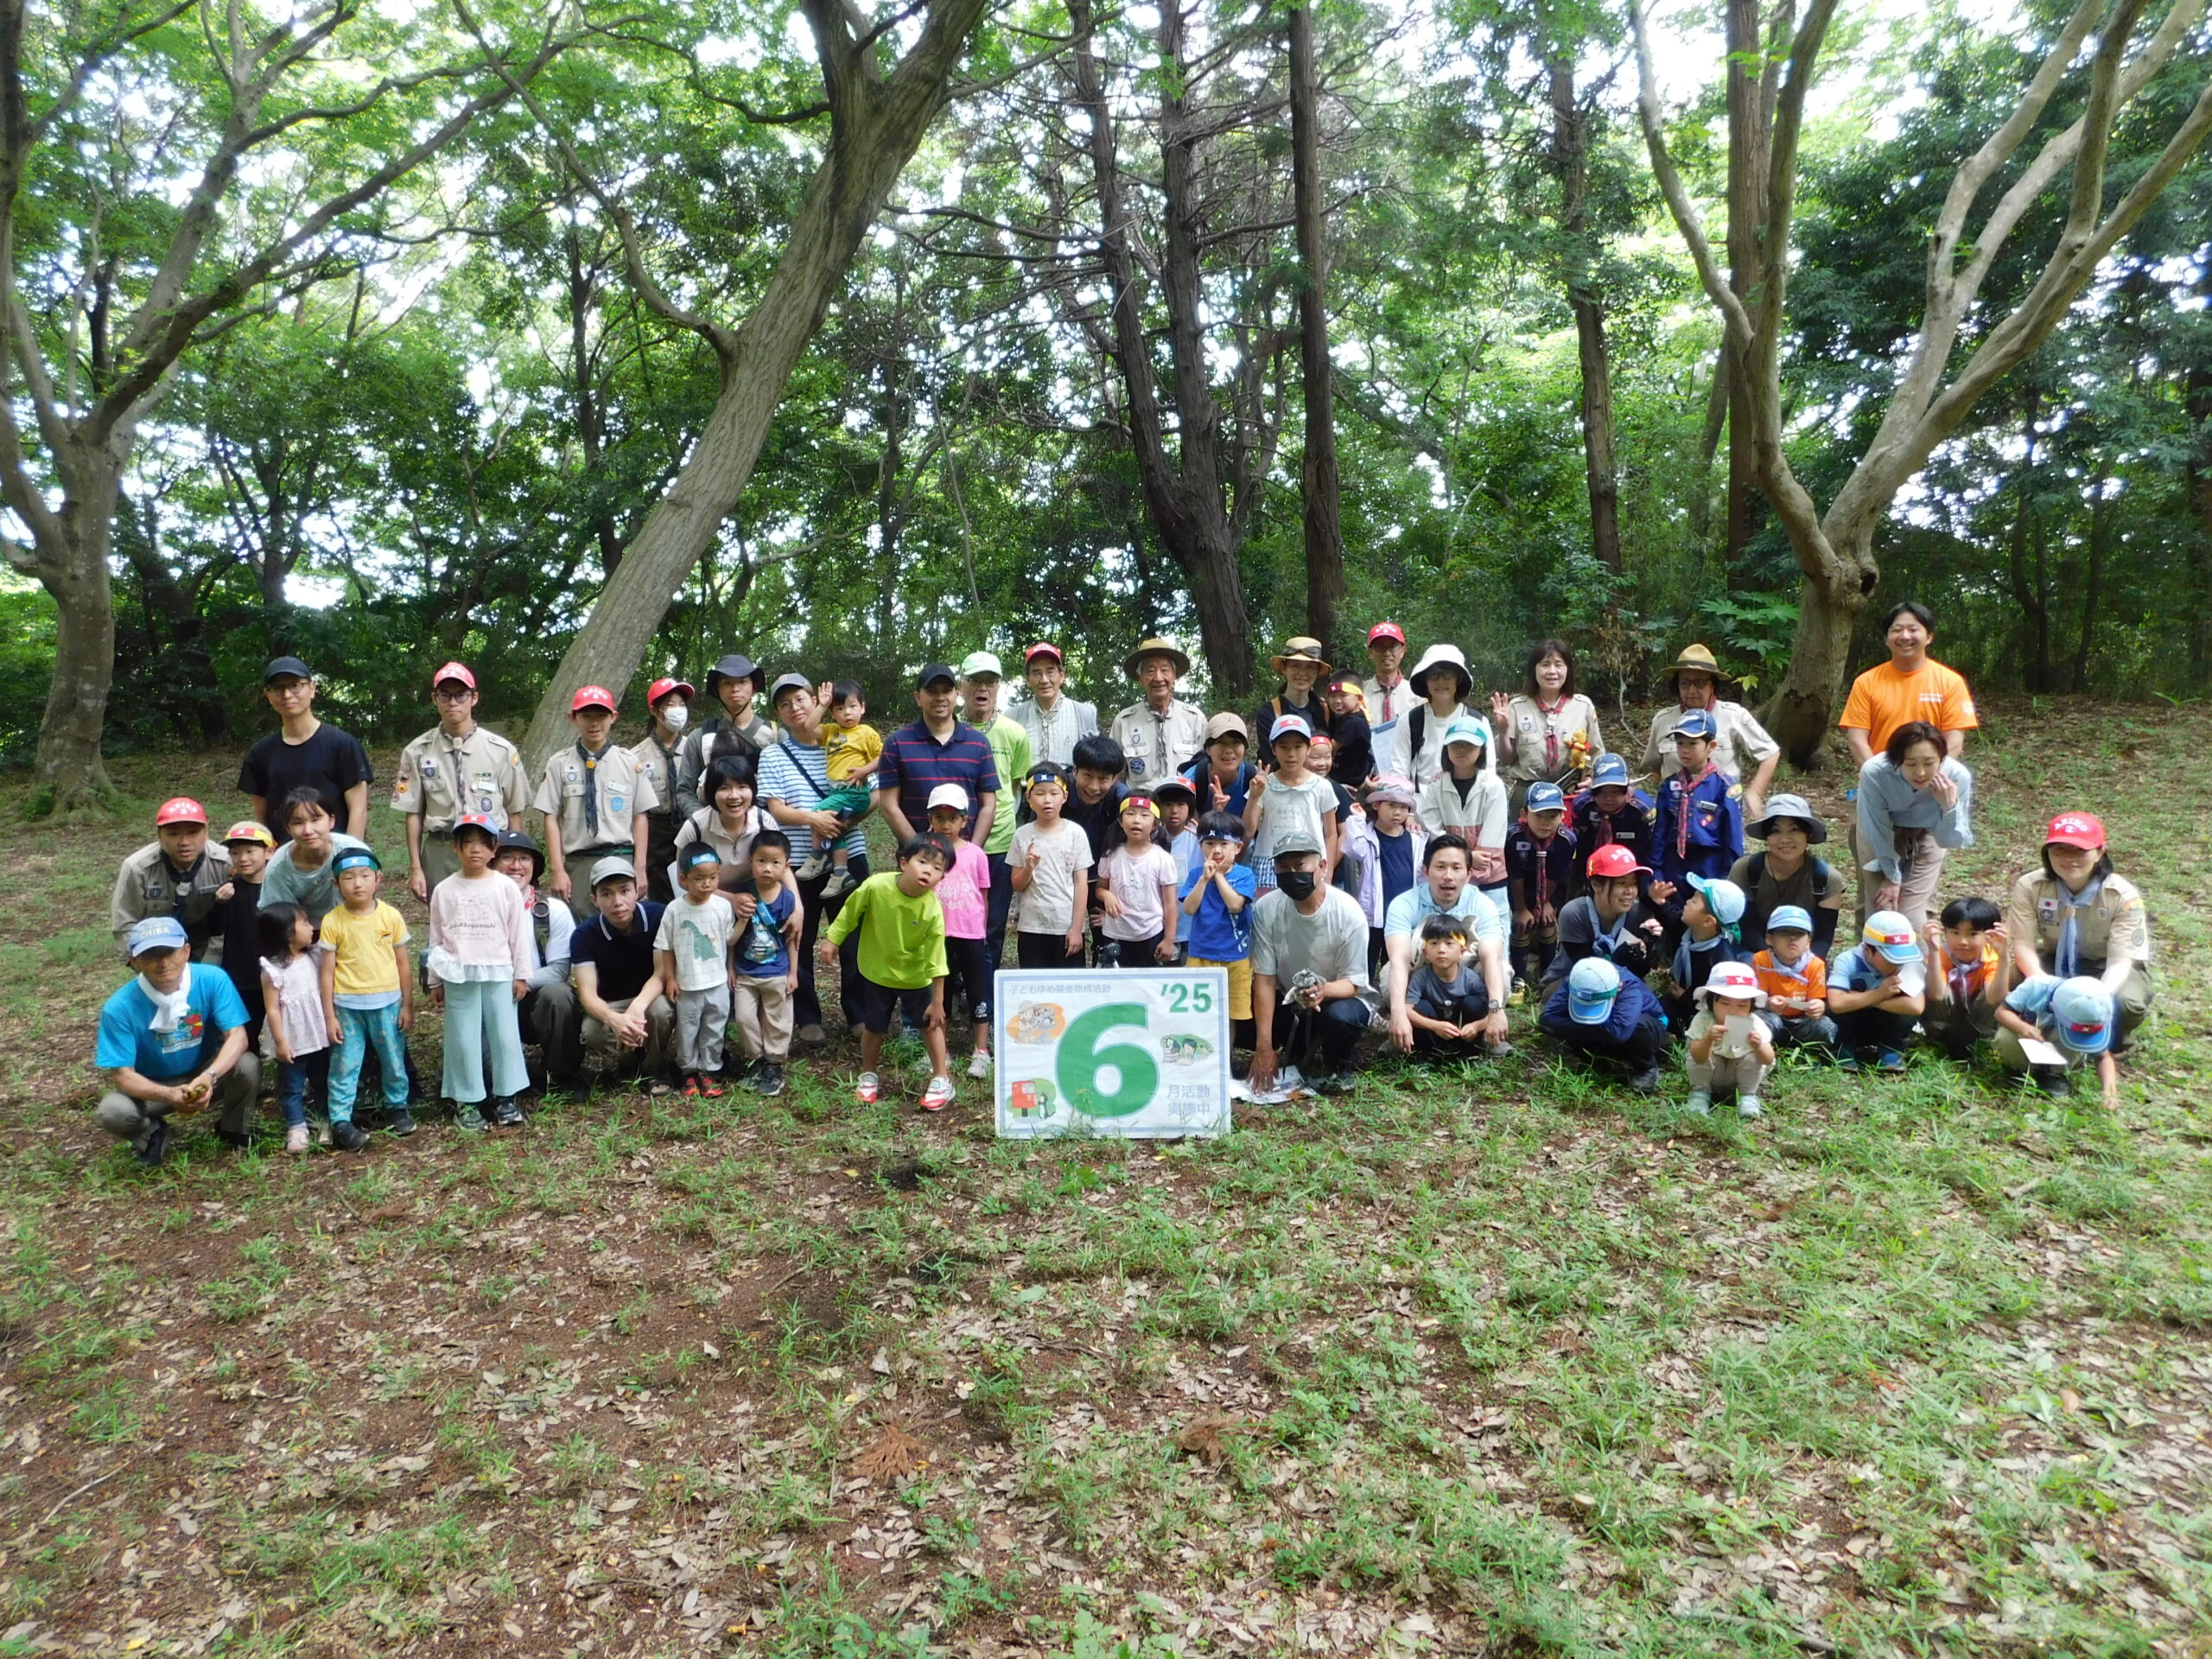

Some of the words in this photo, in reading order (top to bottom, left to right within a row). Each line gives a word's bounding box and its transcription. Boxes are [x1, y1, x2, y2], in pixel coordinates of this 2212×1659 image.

[140, 925, 170, 939] CHIBA
[1160, 983, 1212, 1013] '25
[1056, 1001, 1160, 1119] 6
[1167, 1084, 1210, 1098] 月活動
[1167, 1102, 1210, 1116] 実施中
